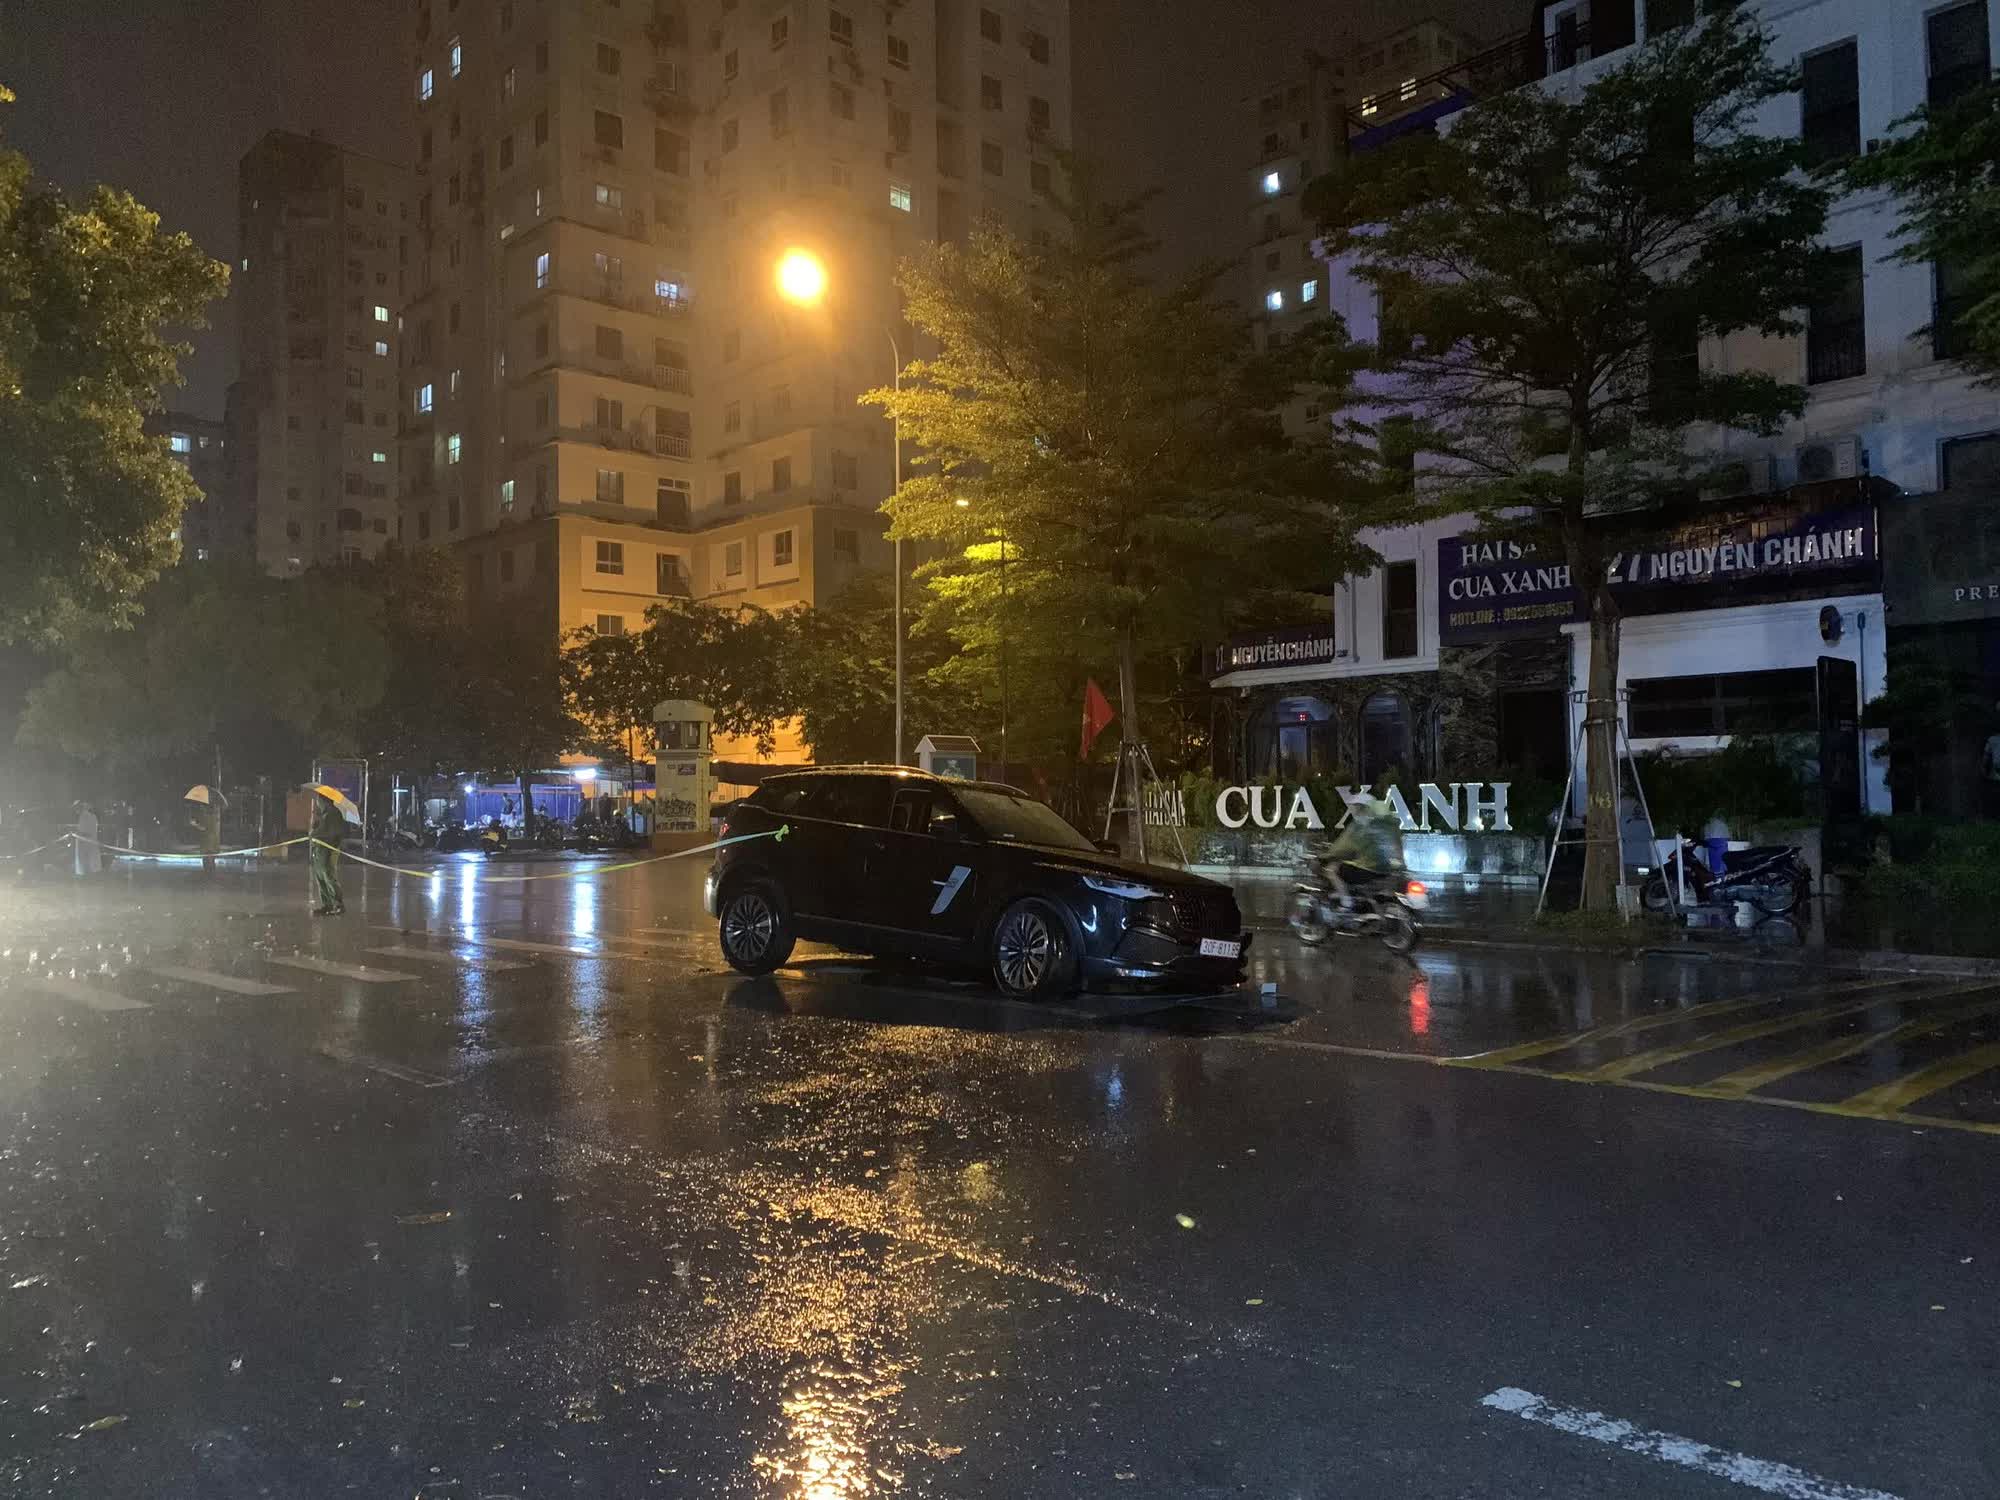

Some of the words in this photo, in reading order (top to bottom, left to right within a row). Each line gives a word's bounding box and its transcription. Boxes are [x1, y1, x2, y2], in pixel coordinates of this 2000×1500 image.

[1651, 535, 1754, 580] NGUYỄN
[1764, 526, 1864, 566] CHÁNH
[1448, 575, 1497, 600] CUA
[1501, 565, 1572, 595] XANH
[1955, 584, 2000, 601] PRE
[1216, 785, 1325, 829] CUA
[1335, 782, 1513, 831] XANH
